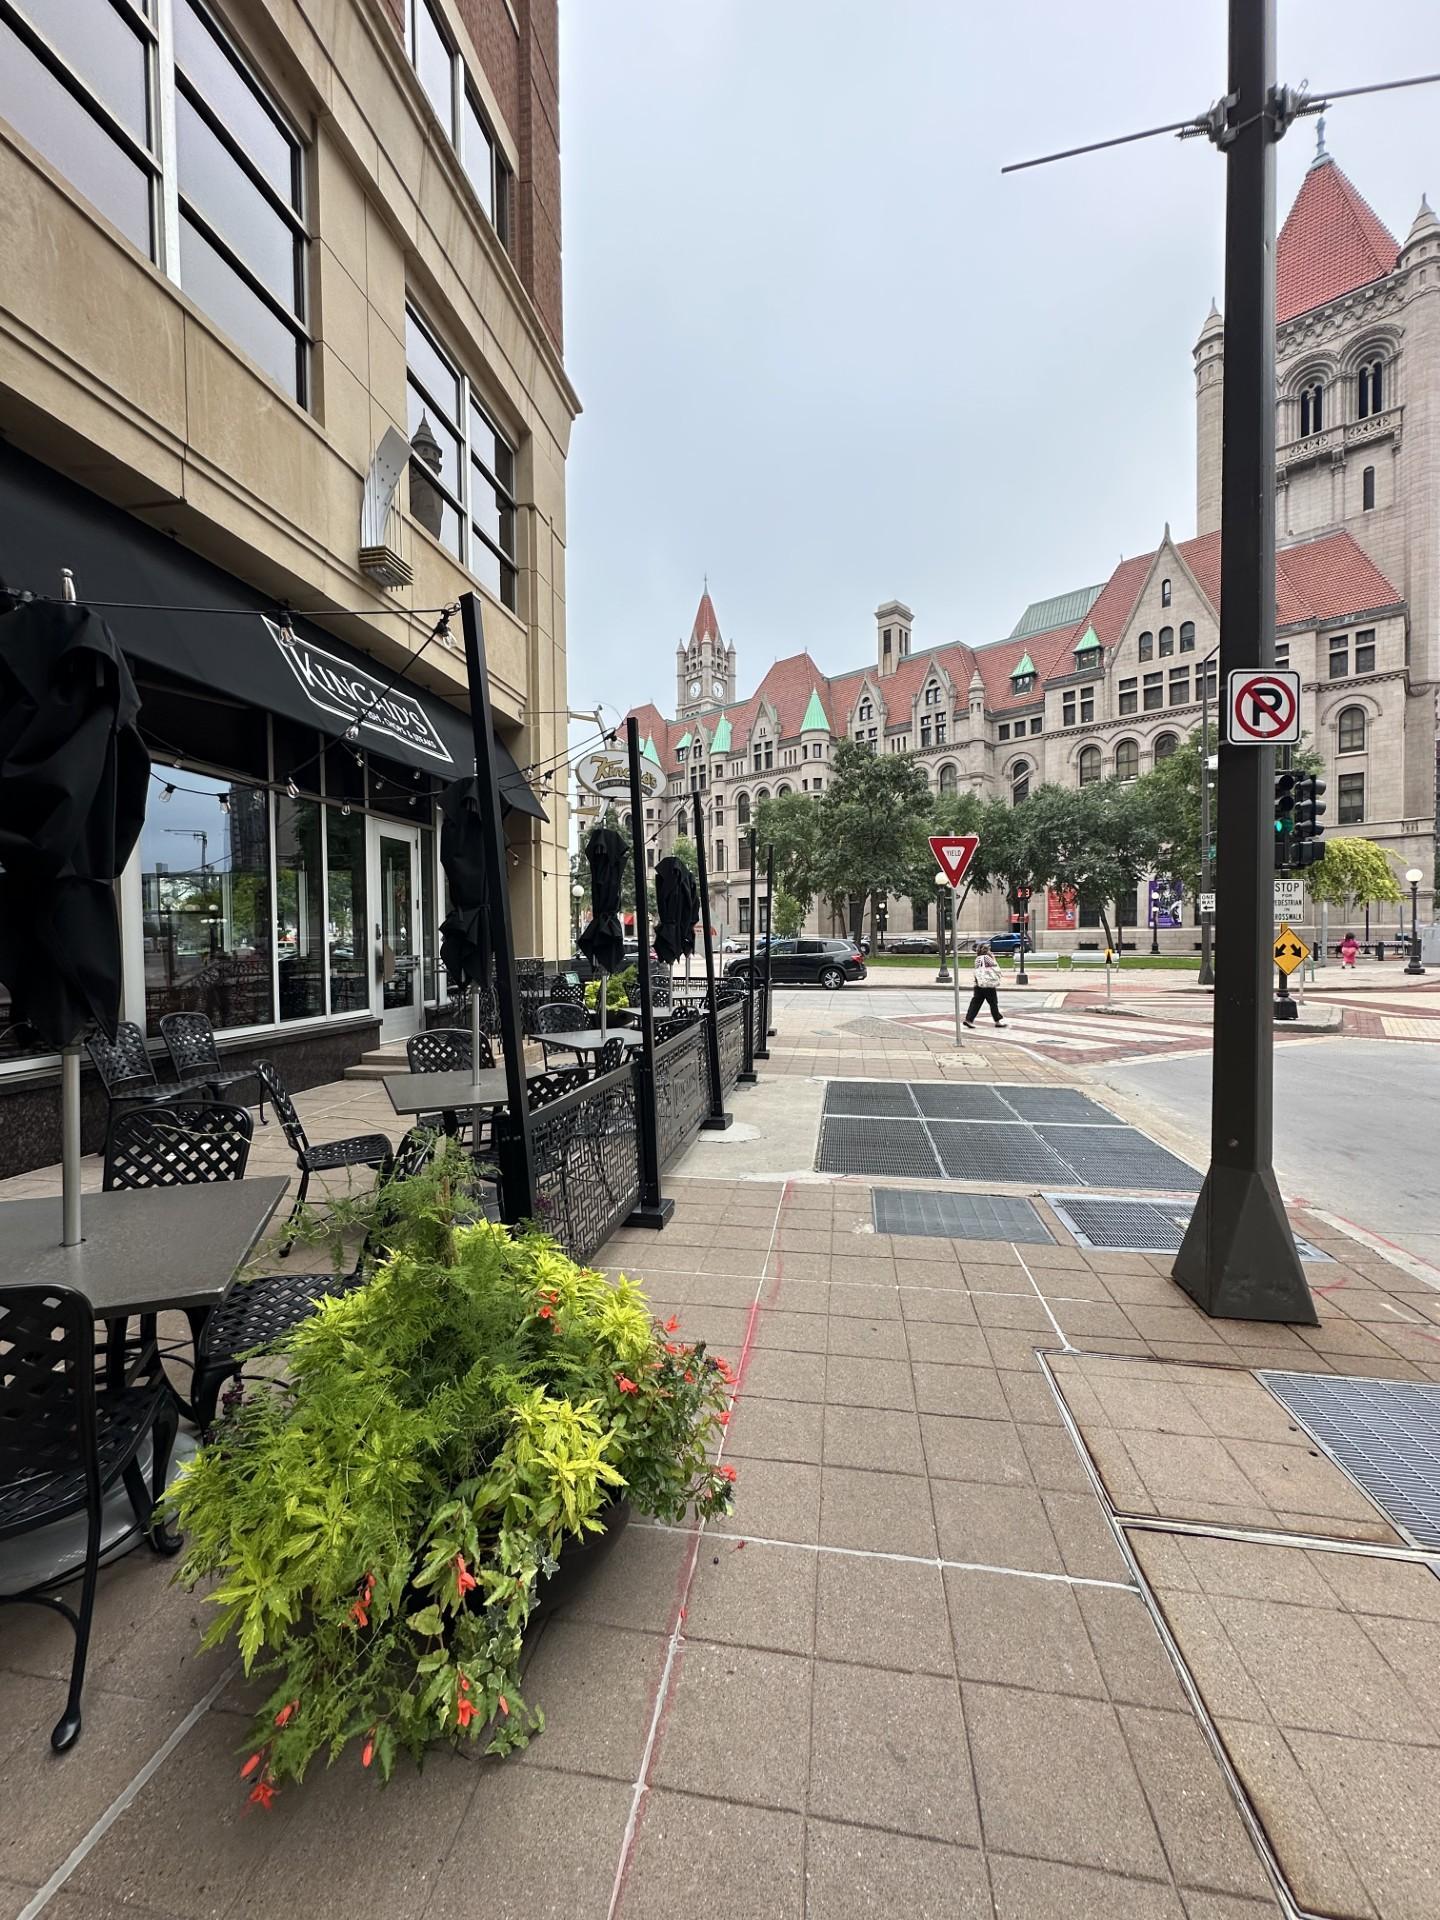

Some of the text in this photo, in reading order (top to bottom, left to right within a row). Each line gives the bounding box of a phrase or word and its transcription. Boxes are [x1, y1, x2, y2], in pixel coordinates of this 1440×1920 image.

[290, 646, 428, 735] KINCAID'S
[1253, 688, 1282, 726] P
[1275, 882, 1300, 892] STOP
